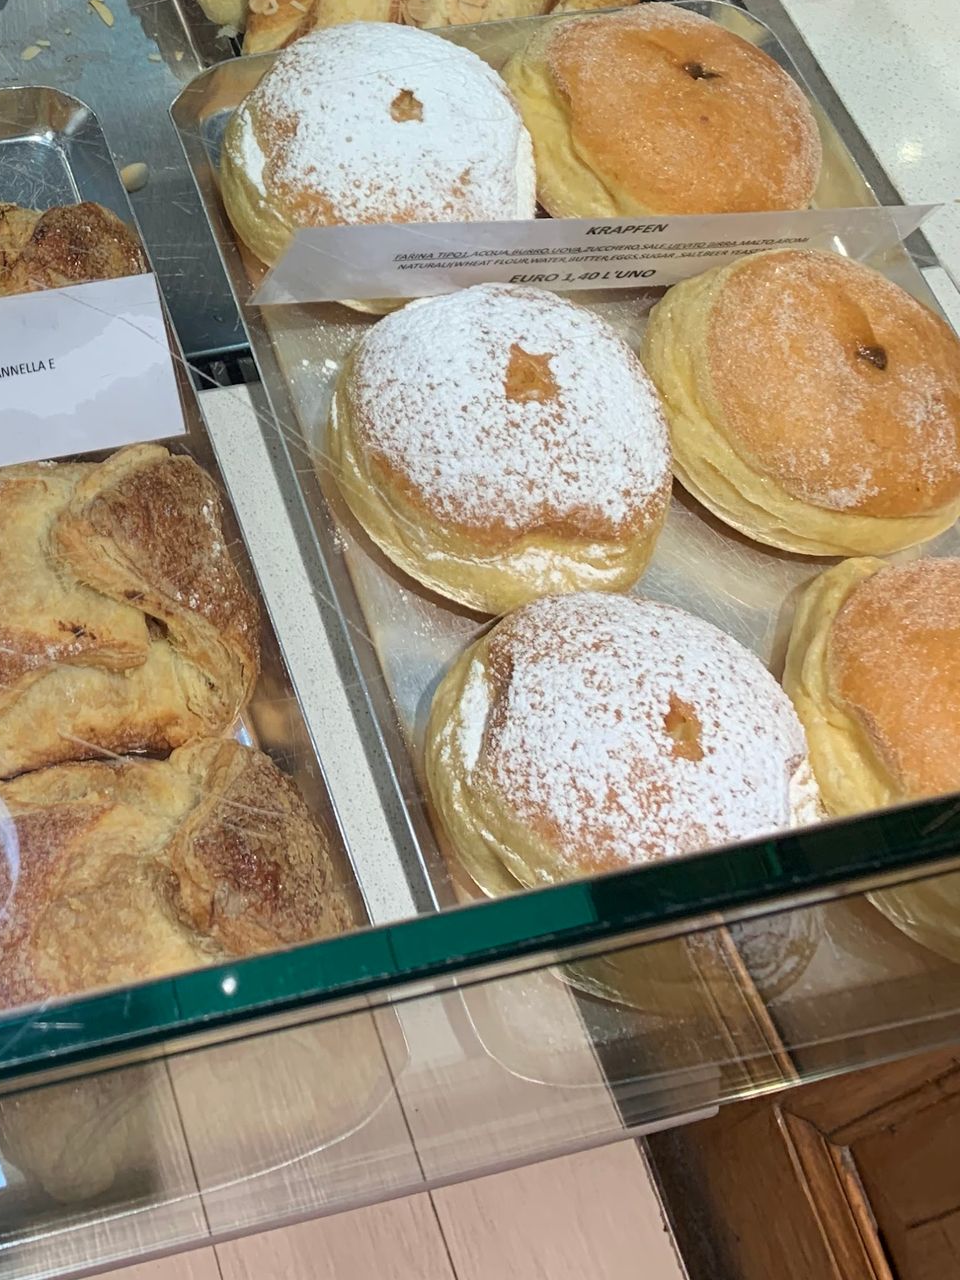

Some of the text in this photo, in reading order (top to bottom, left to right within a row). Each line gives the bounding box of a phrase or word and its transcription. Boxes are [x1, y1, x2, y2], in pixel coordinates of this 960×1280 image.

[586, 223, 669, 236] KRAPFEN
[393, 252, 434, 261] FARINA
[509, 269, 657, 283] EURO 1,40 L'UNO
[48, 358, 56, 370] E
